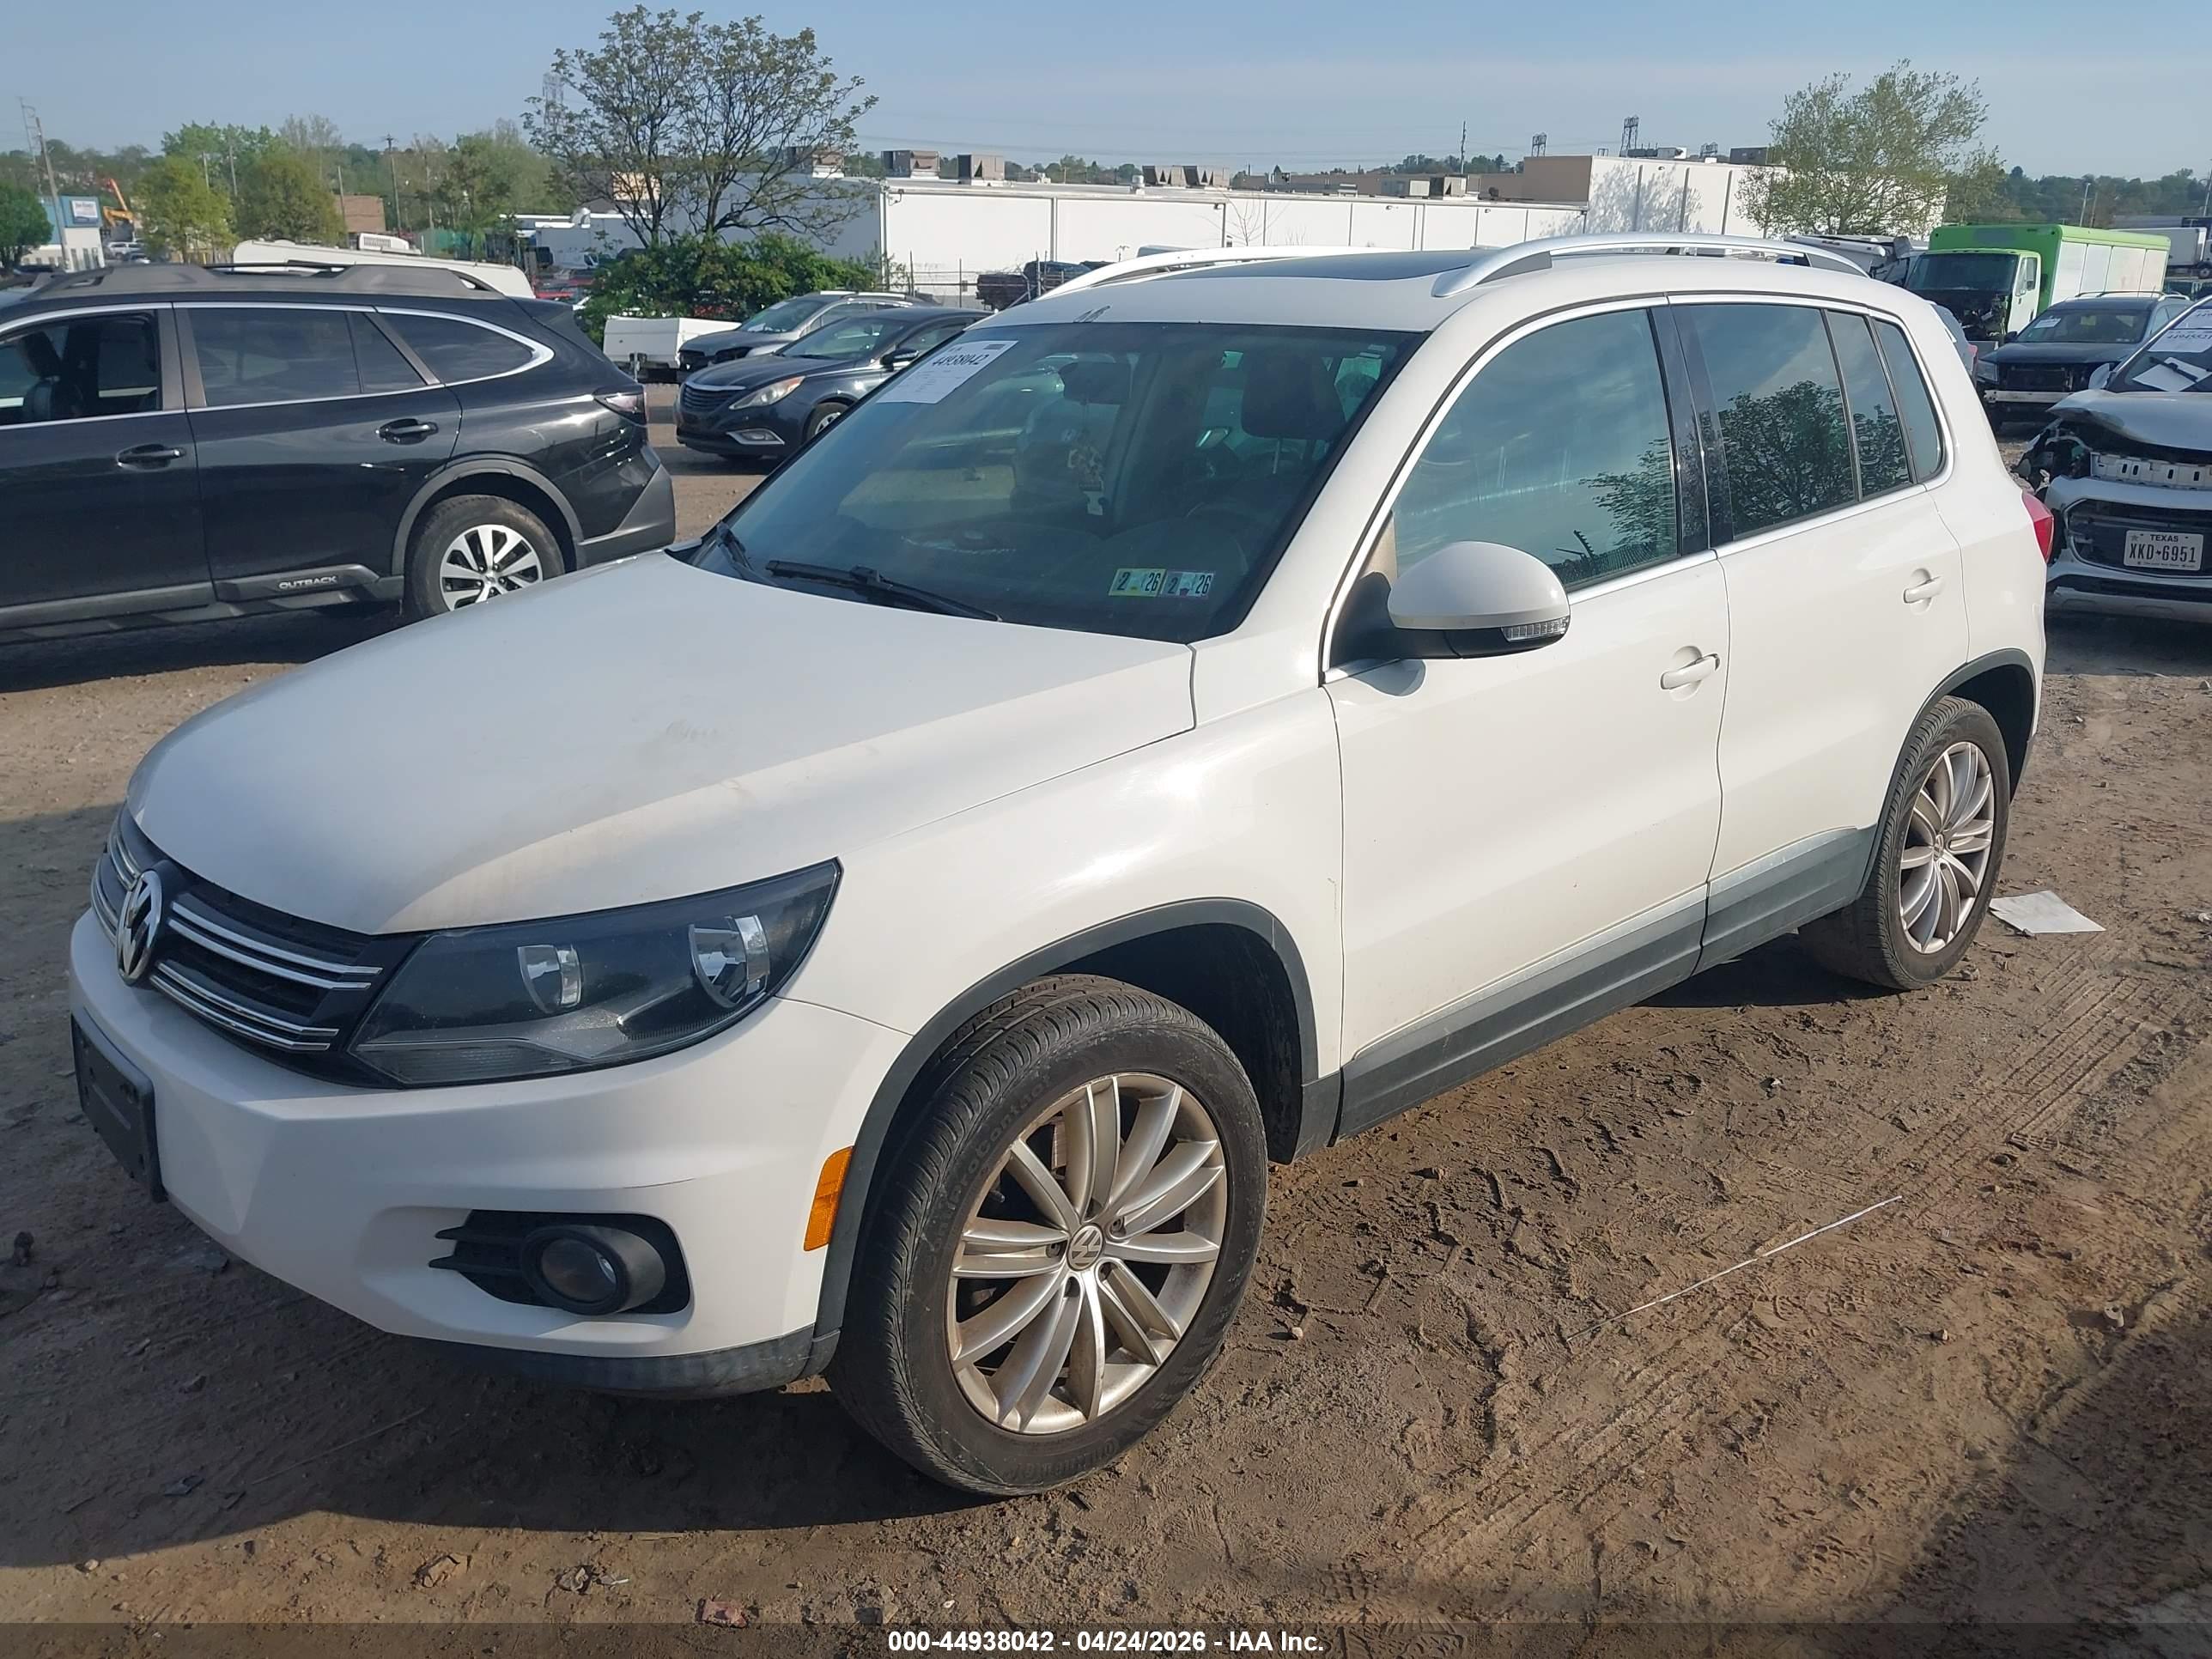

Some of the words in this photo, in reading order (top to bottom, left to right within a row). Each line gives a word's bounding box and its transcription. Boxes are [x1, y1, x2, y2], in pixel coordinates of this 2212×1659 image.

[932, 354, 990, 367] 44938042
[2149, 533, 2179, 543] TEXAS
[278, 575, 337, 589] OUTBACK
[1116, 571, 1131, 591] 2
[1145, 572, 1162, 592] 26
[1167, 576, 1179, 594] 2
[1194, 574, 1212, 594] 26
